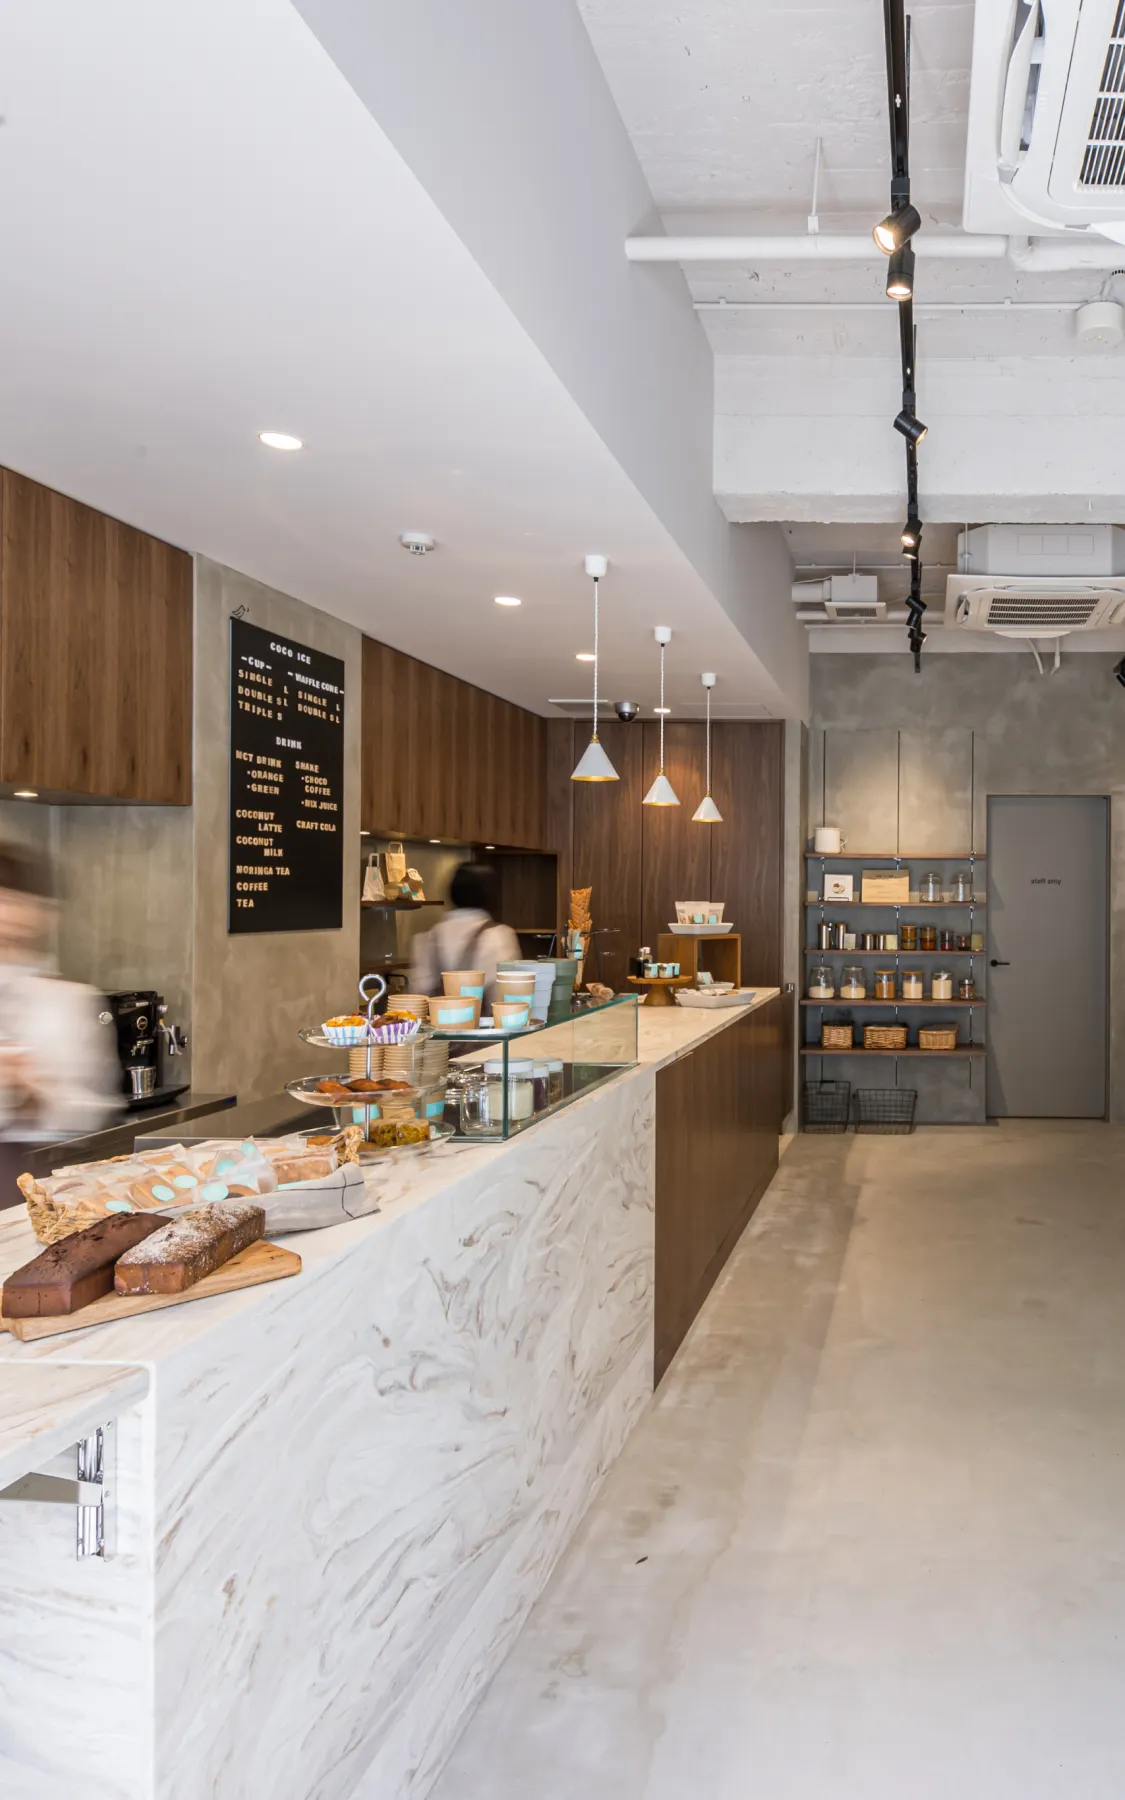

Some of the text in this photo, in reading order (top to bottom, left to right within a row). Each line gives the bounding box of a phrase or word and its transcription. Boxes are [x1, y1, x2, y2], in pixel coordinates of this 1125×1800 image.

[270, 642, 311, 664] COCO ICE
[238, 669, 288, 694] SINGLE L
[238, 686, 273, 704] DOUBLE
[298, 691, 327, 706] SINGLE
[238, 700, 282, 720] TRIPLE S
[298, 704, 326, 720] DOUBLE
[276, 736, 302, 750] DRINK
[257, 756, 282, 768] DRINK
[295, 761, 319, 773] SHAKE
[305, 785, 331, 796] COFFEE
[319, 801, 338, 811] JUICE
[236, 809, 275, 820] COCONUT
[258, 823, 282, 833] LATTE
[296, 820, 336, 832] CRAFT COLA
[236, 836, 273, 846] COCONUT
[264, 848, 283, 857] MILK
[236, 865, 290, 876] MORINGA TEA
[236, 882, 268, 891] COFFEE
[237, 899, 254, 908] TEA
